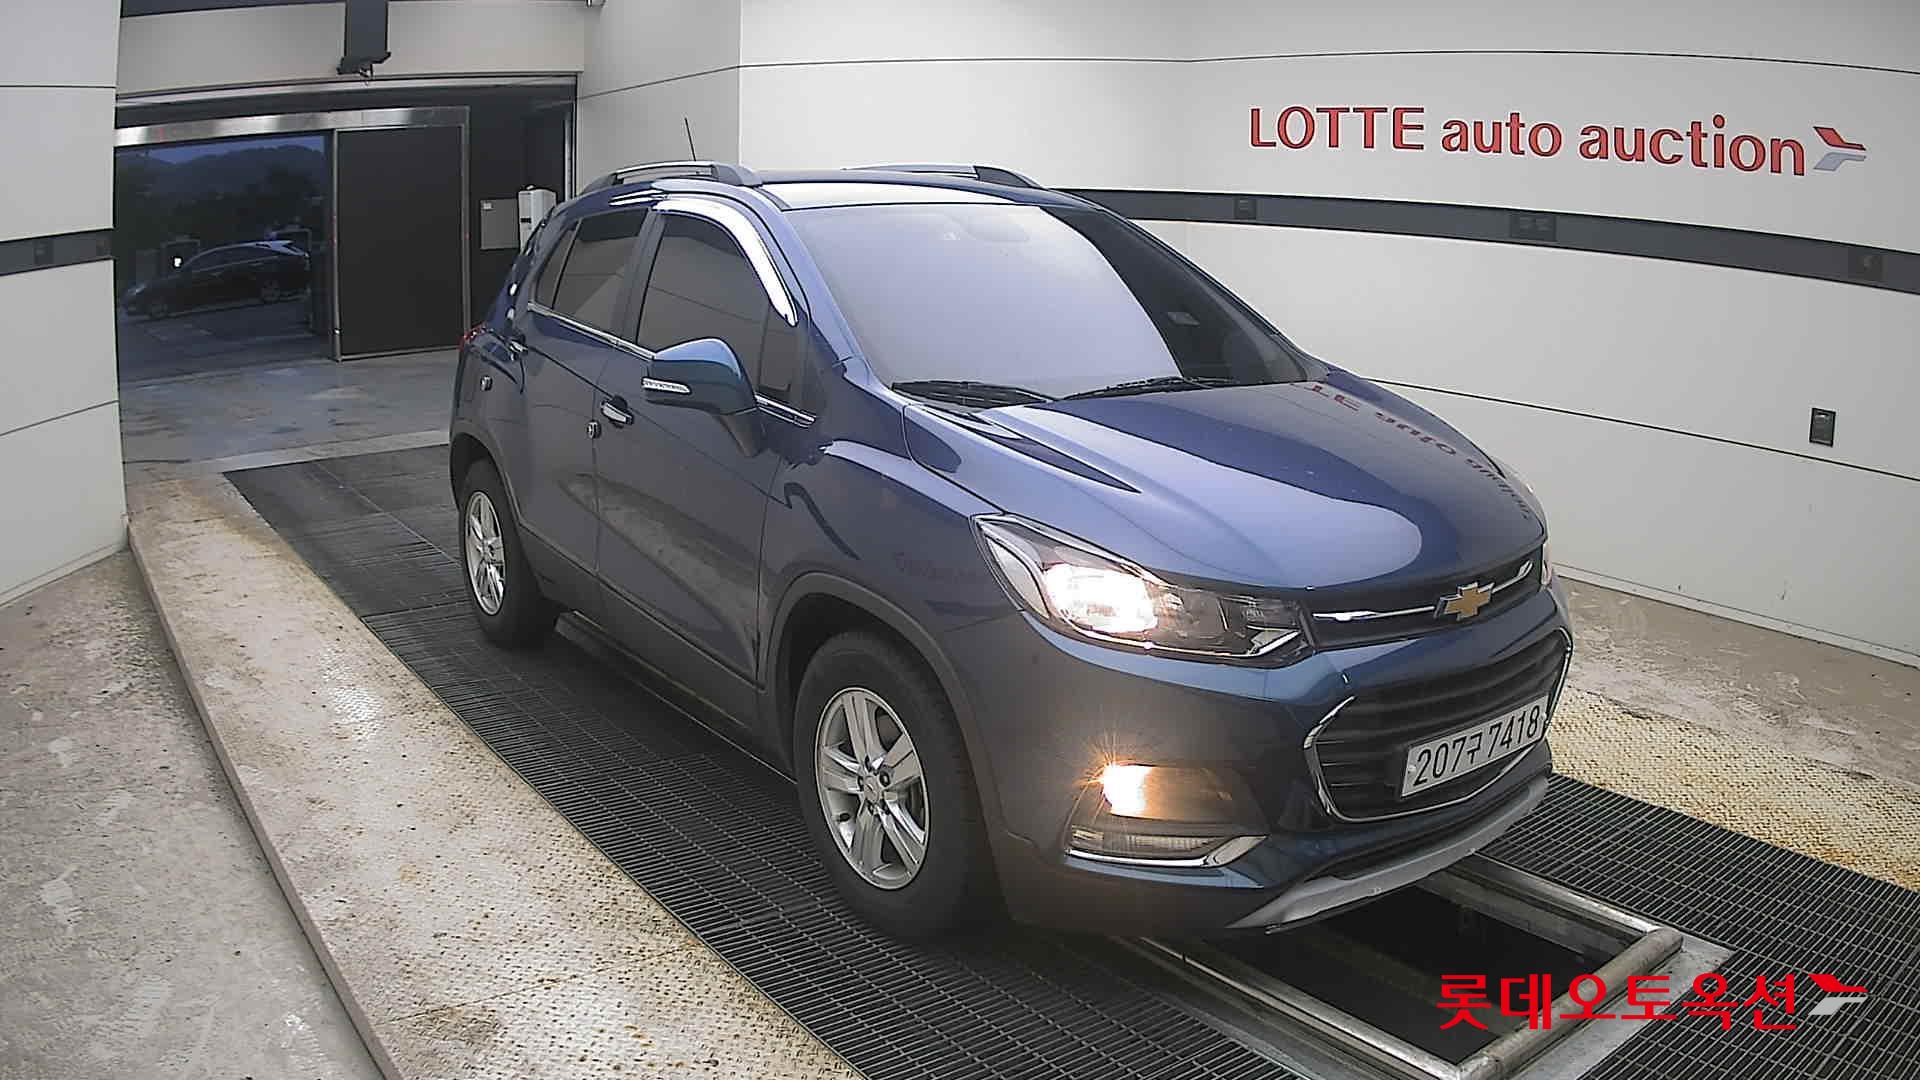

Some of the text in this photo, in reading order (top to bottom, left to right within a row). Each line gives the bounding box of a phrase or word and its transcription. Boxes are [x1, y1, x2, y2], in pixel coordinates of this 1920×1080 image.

[1250, 106, 1807, 176] LOTTE auto auction
[1488, 705, 1541, 758] 7418
